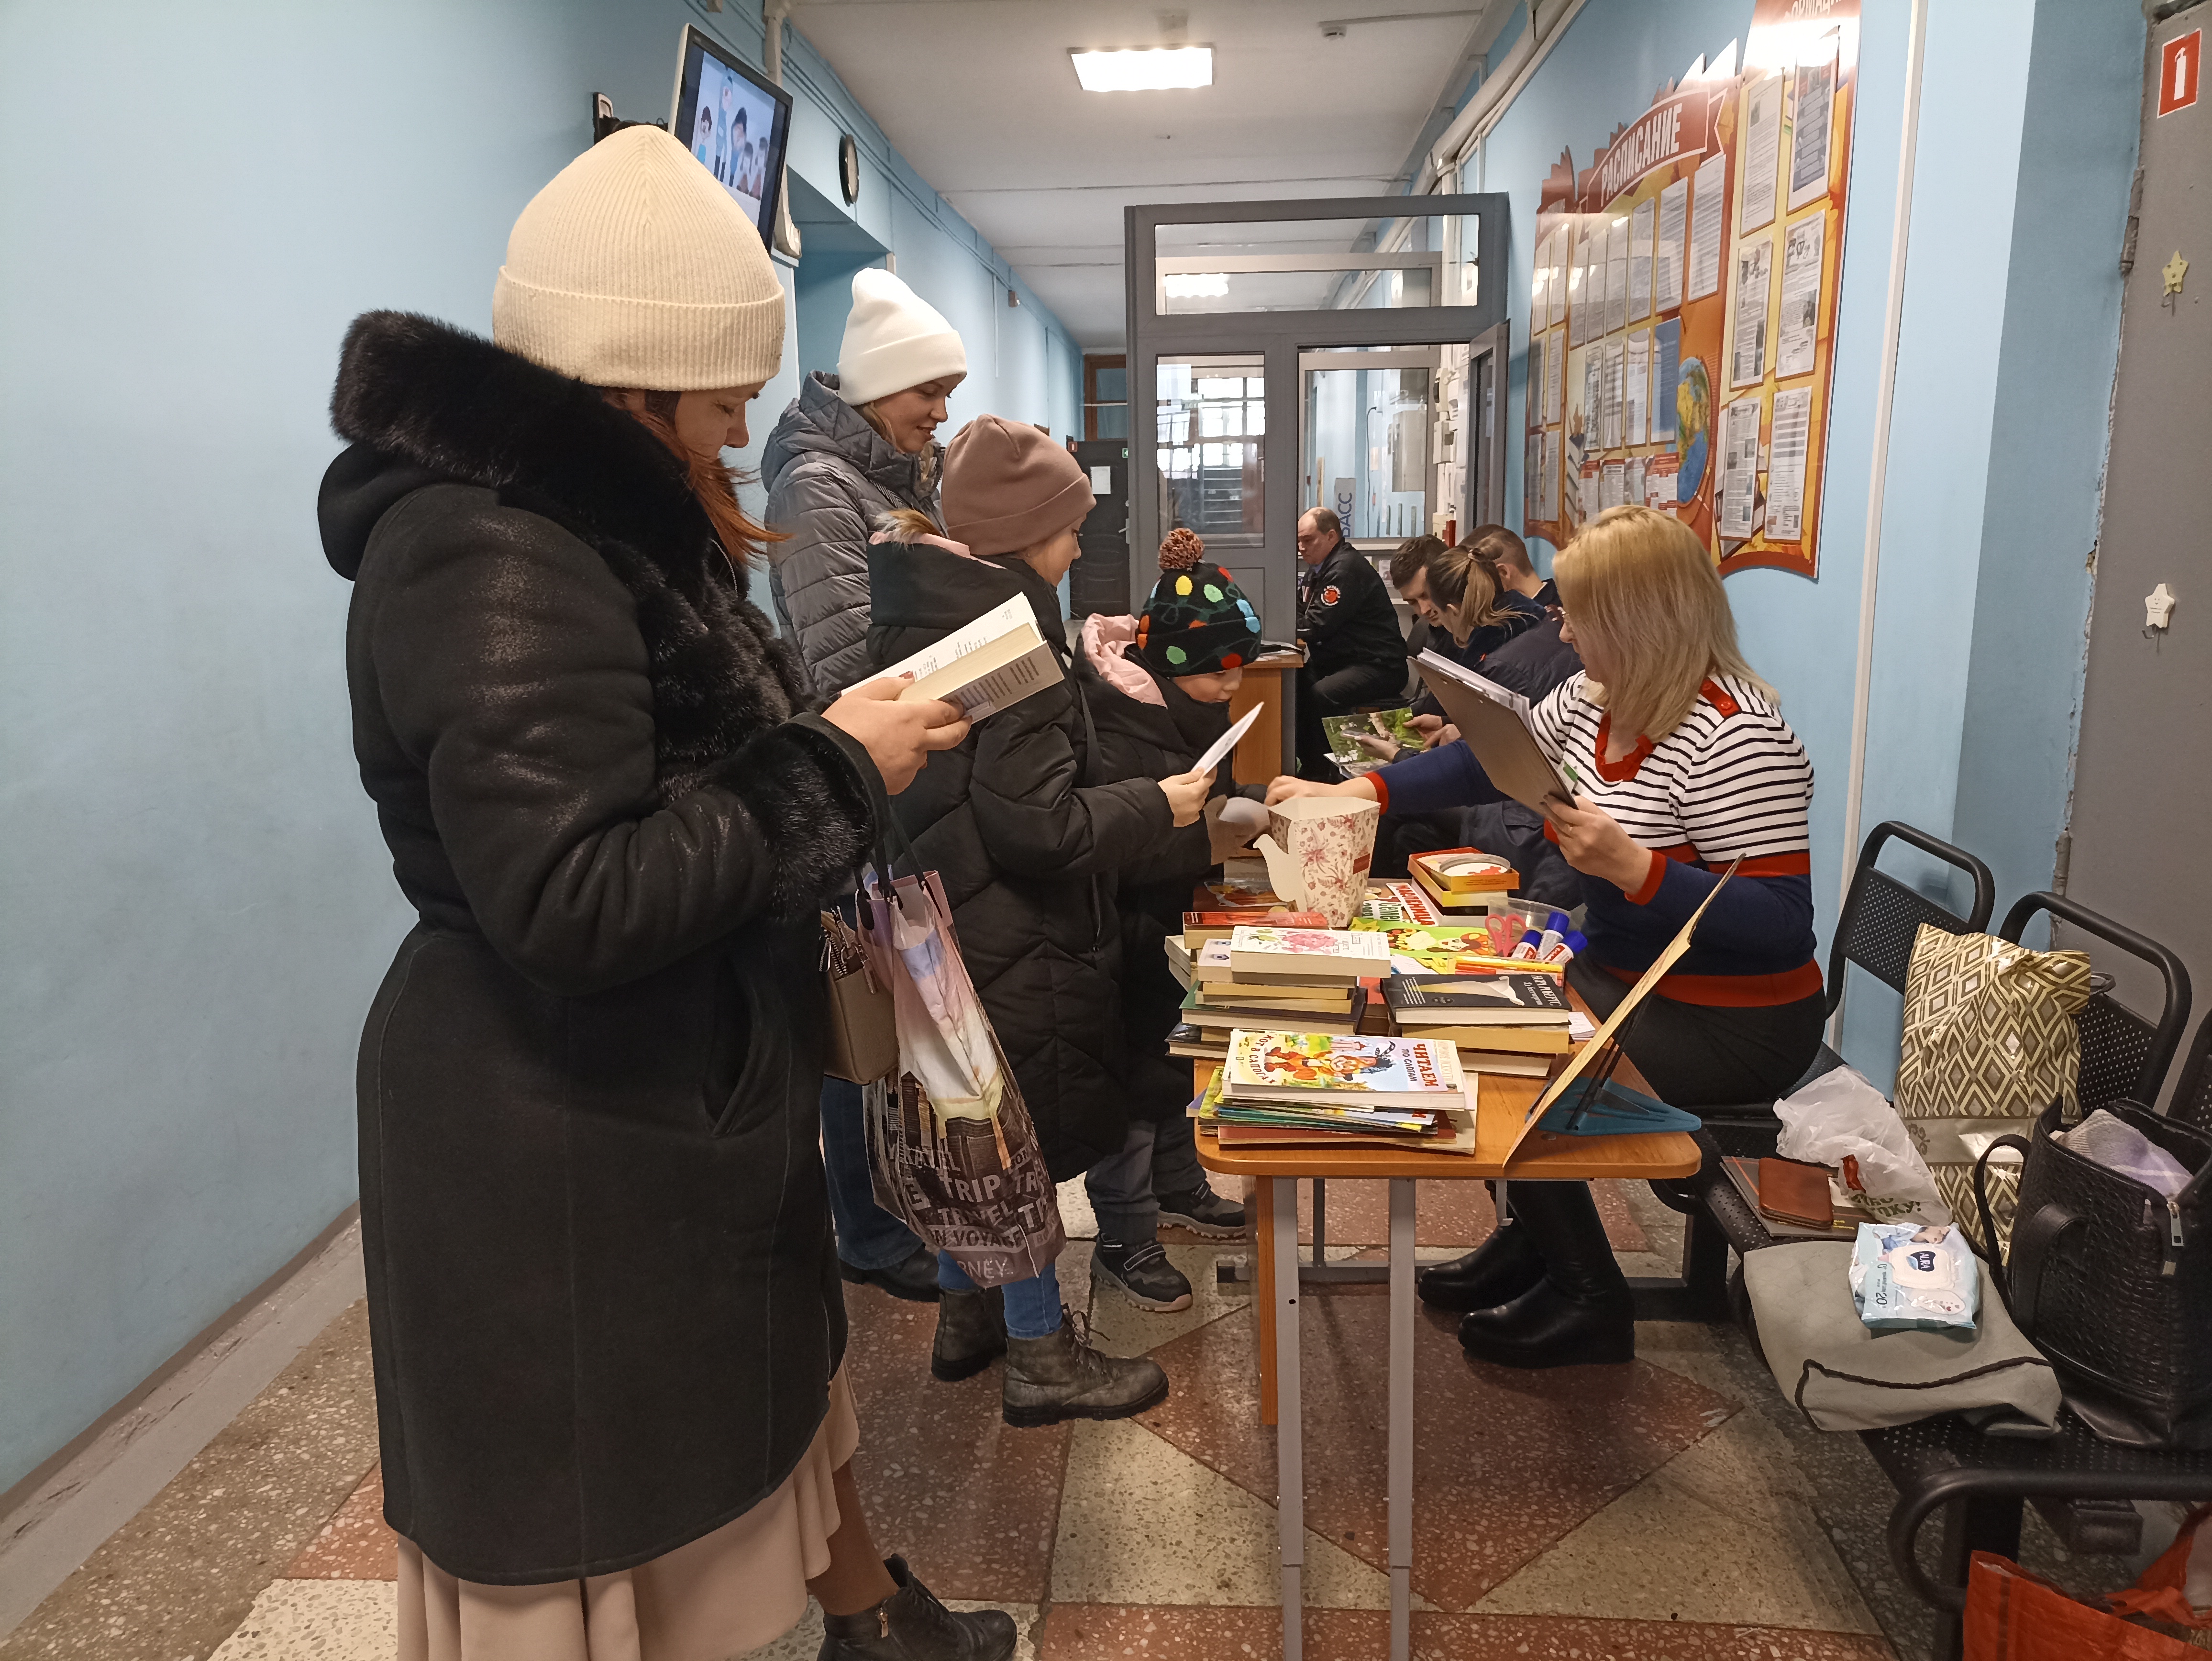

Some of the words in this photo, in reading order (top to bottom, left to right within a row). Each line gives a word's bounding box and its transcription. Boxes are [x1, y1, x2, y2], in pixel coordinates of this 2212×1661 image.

[1601, 102, 1682, 207] РАСПИСАНИЕ
[1396, 885, 1436, 926] МАСЛЕНИЦА
[1531, 975, 1548, 986] НОРА
[1538, 986, 1562, 1006] РОБЕРТС
[1256, 1035, 1274, 1046] КОТ
[1401, 1049, 1410, 1057] ПО
[1249, 1054, 1277, 1084] САПОГАХ
[1404, 1059, 1417, 1082] СЛОГАМ
[1413, 1043, 1439, 1087] ЧИТАЕМ
[939, 1174, 1001, 1202] TRIP
[937, 1200, 1013, 1228] TRAVEL
[1919, 1252, 1931, 1269] AURA
[1875, 1292, 1888, 1305] 20
